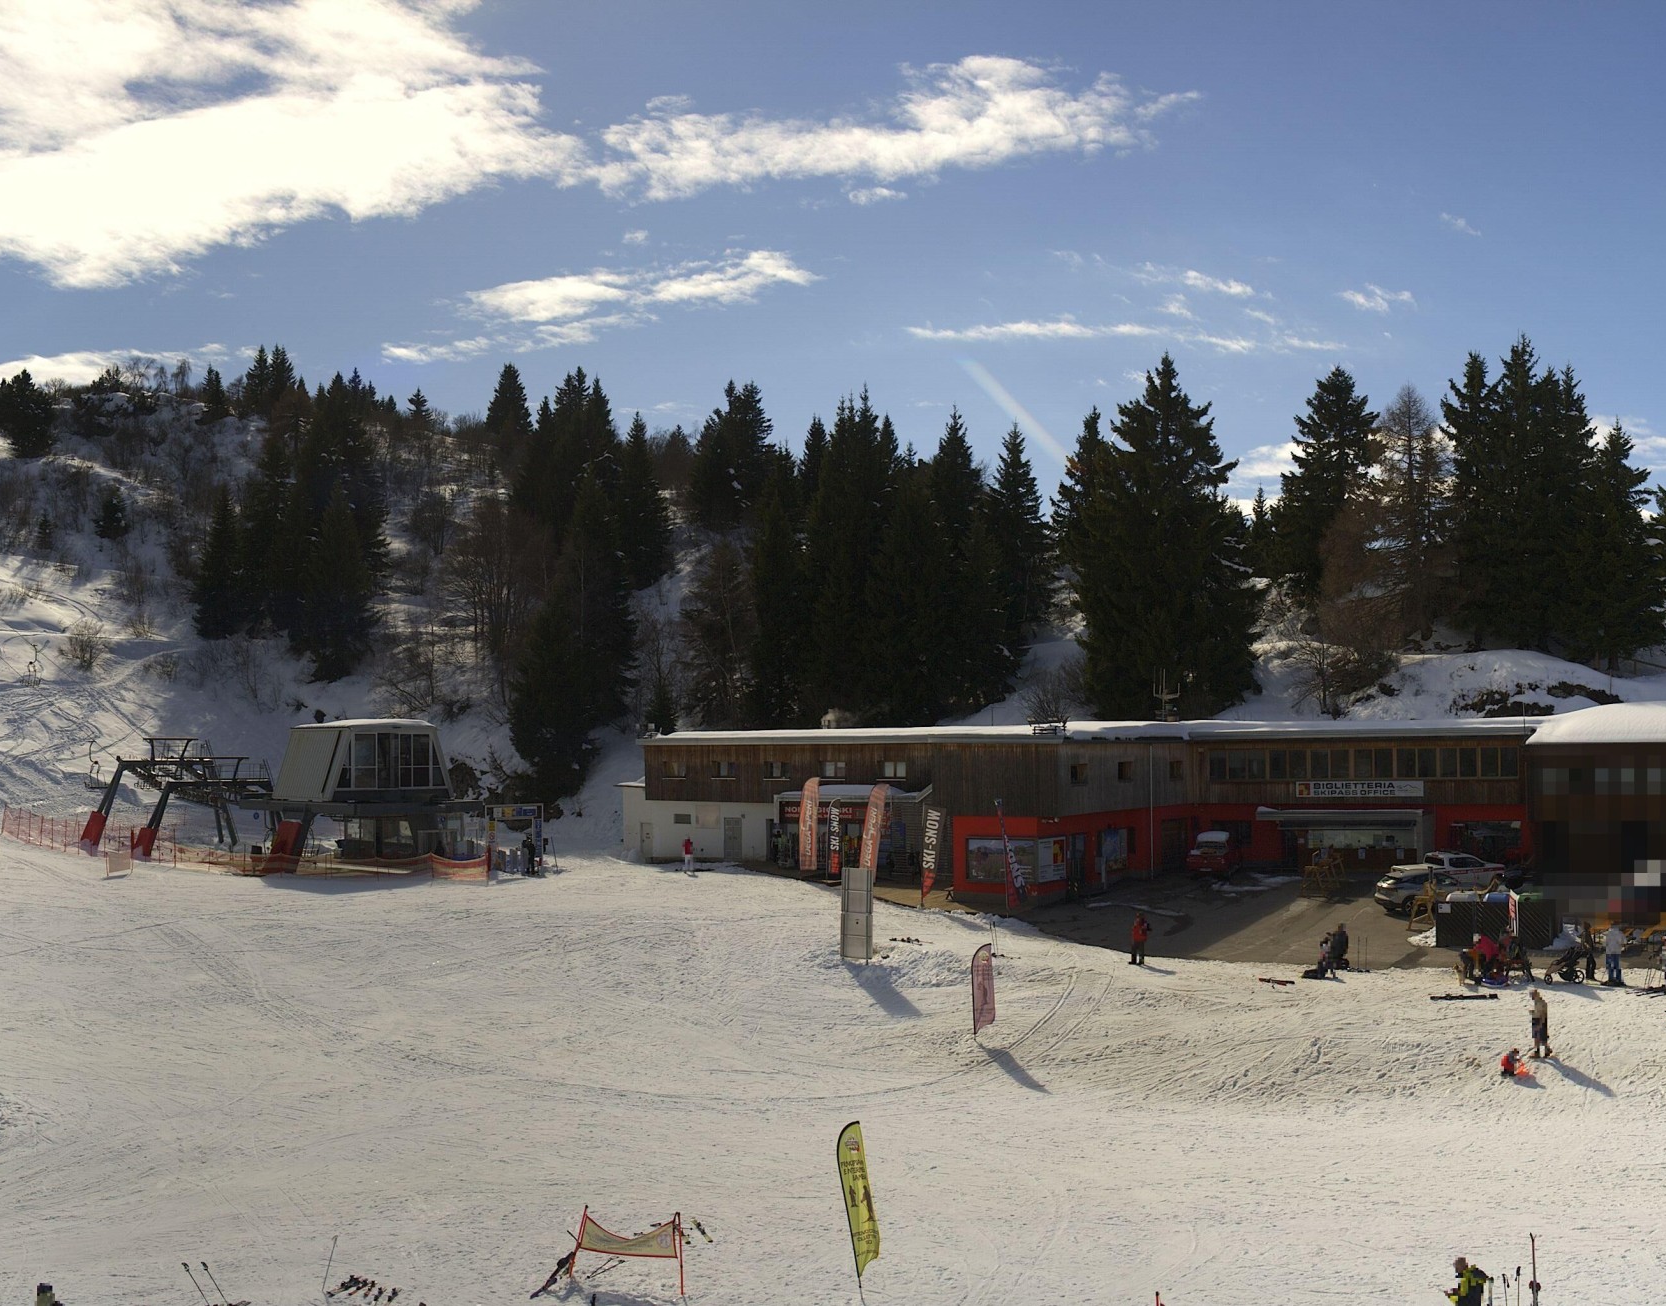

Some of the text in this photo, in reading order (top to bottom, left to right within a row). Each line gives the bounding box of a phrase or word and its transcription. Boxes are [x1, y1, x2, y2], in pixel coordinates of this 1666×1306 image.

[1313, 782, 1395, 790] BIGLIETTERIA
[830, 806, 840, 851] SKI-SNOW
[922, 809, 941, 870] SKI-SNOW
